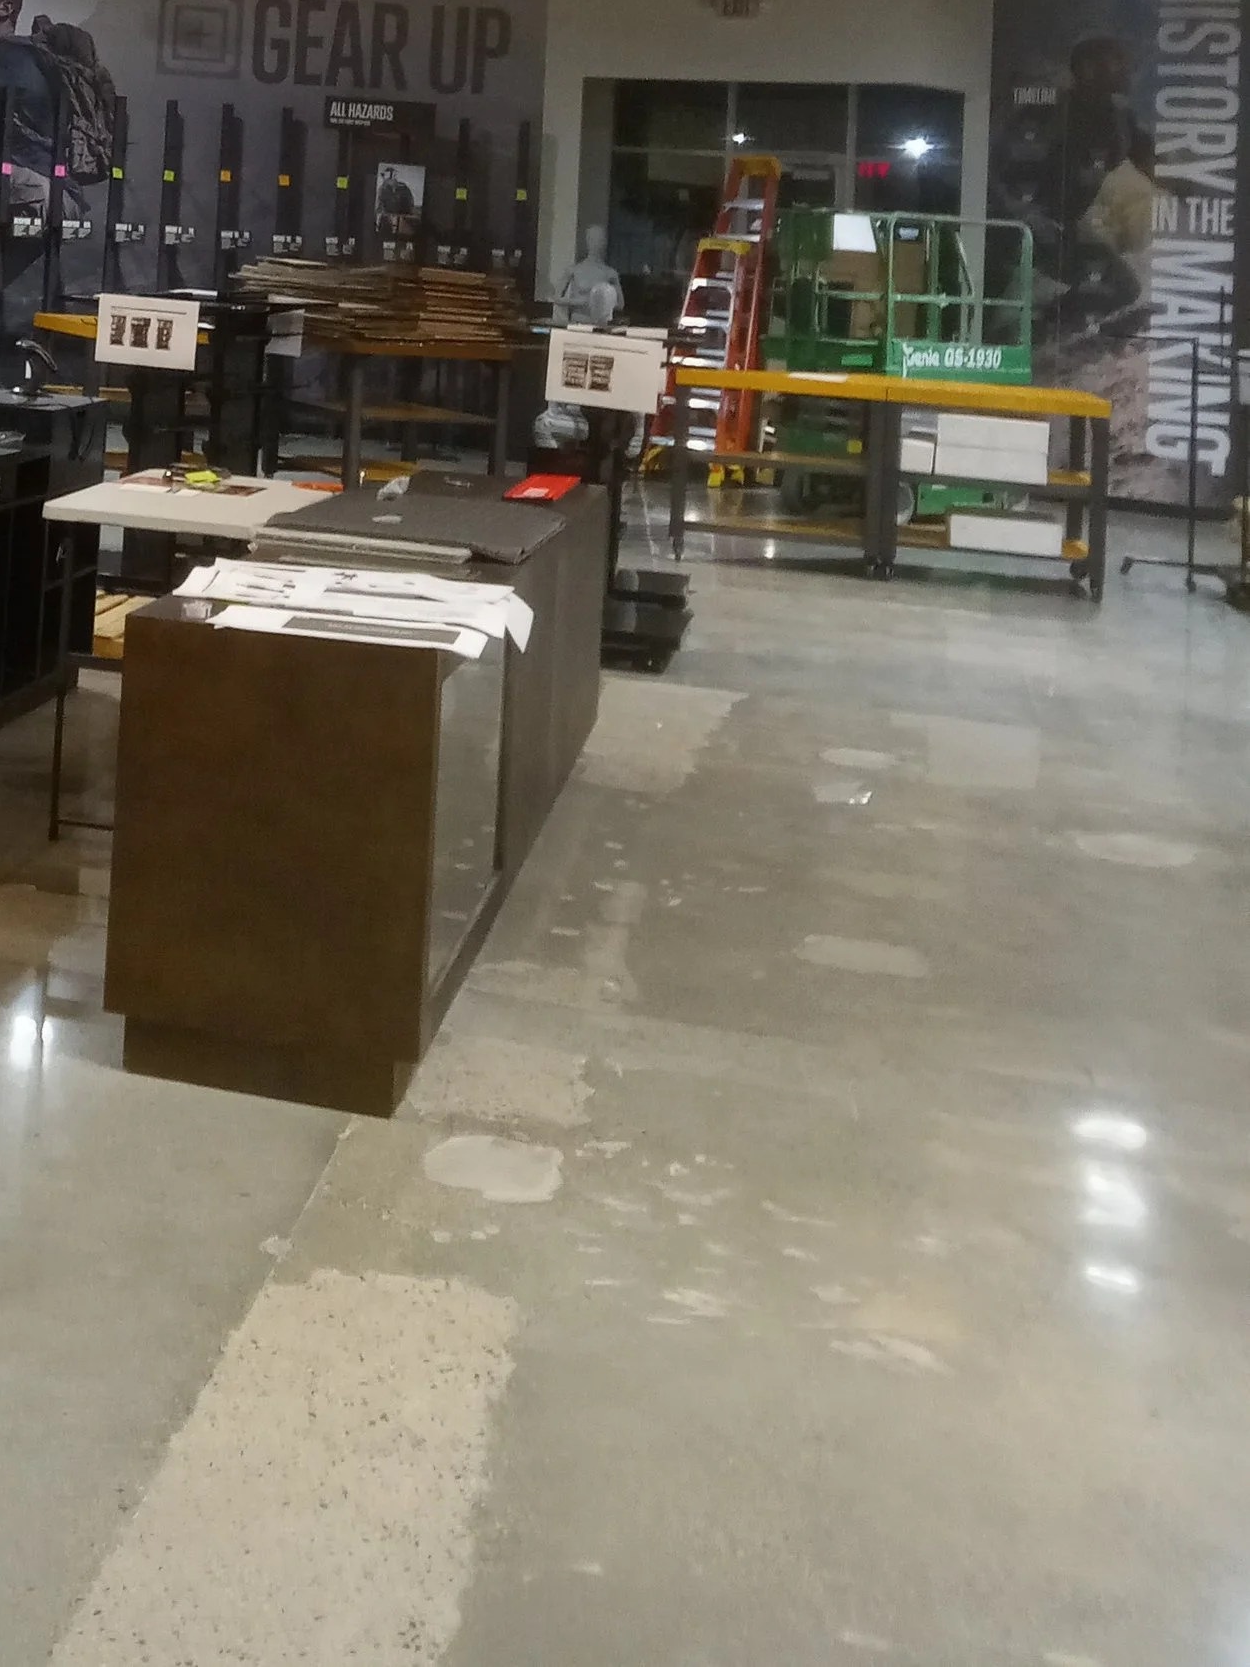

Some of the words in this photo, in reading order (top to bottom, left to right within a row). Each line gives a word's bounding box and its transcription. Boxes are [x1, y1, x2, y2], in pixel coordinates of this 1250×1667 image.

[429, 5, 512, 94] UP
[330, 101, 346, 117] ALL
[348, 102, 394, 122] HAZARDS
[1151, 197, 1178, 232] IN
[1186, 196, 1235, 235] THE
[1147, 239, 1235, 478] MAKING
